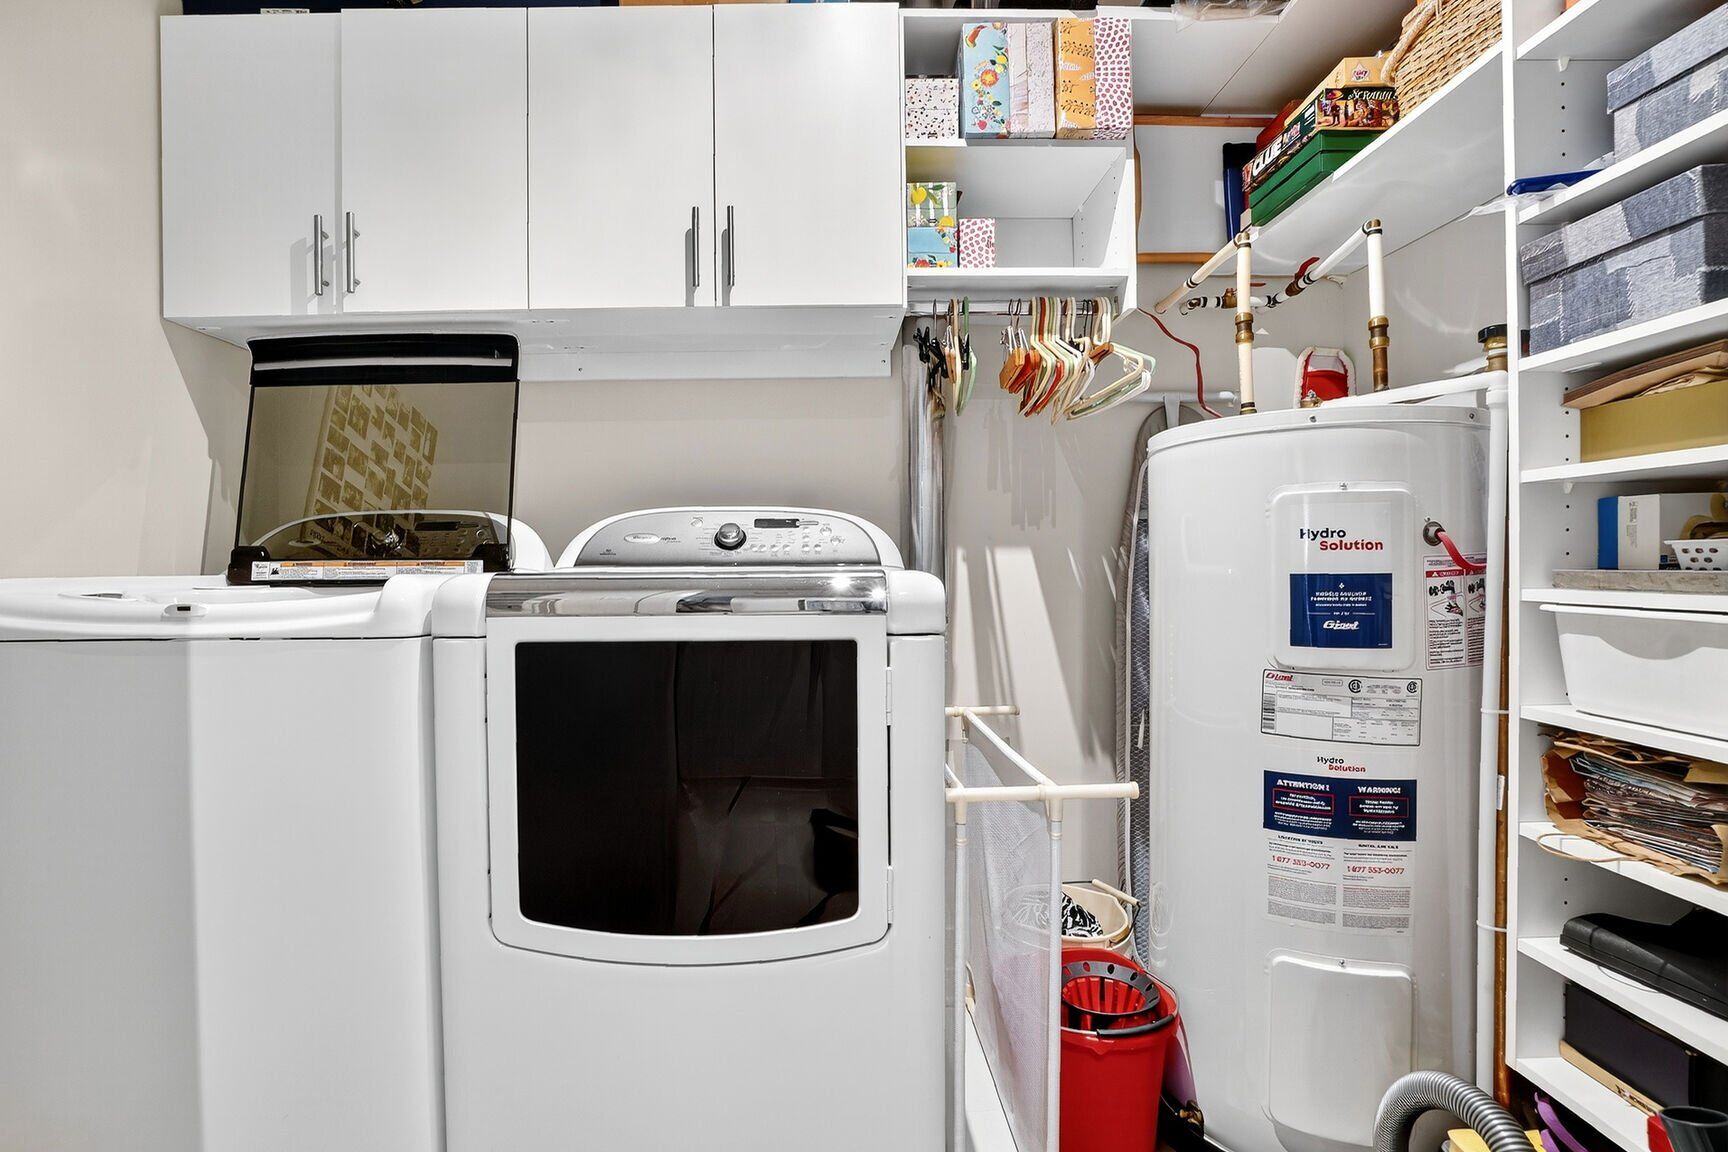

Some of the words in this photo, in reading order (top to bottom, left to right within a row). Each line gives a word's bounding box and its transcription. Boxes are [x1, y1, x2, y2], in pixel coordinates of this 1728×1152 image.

[1252, 134, 1285, 177] CLUE
[1299, 528, 1347, 541] Hydro
[1319, 539, 1384, 551] Solution
[1316, 755, 1345, 765] Hydro
[1328, 763, 1367, 773] Solution
